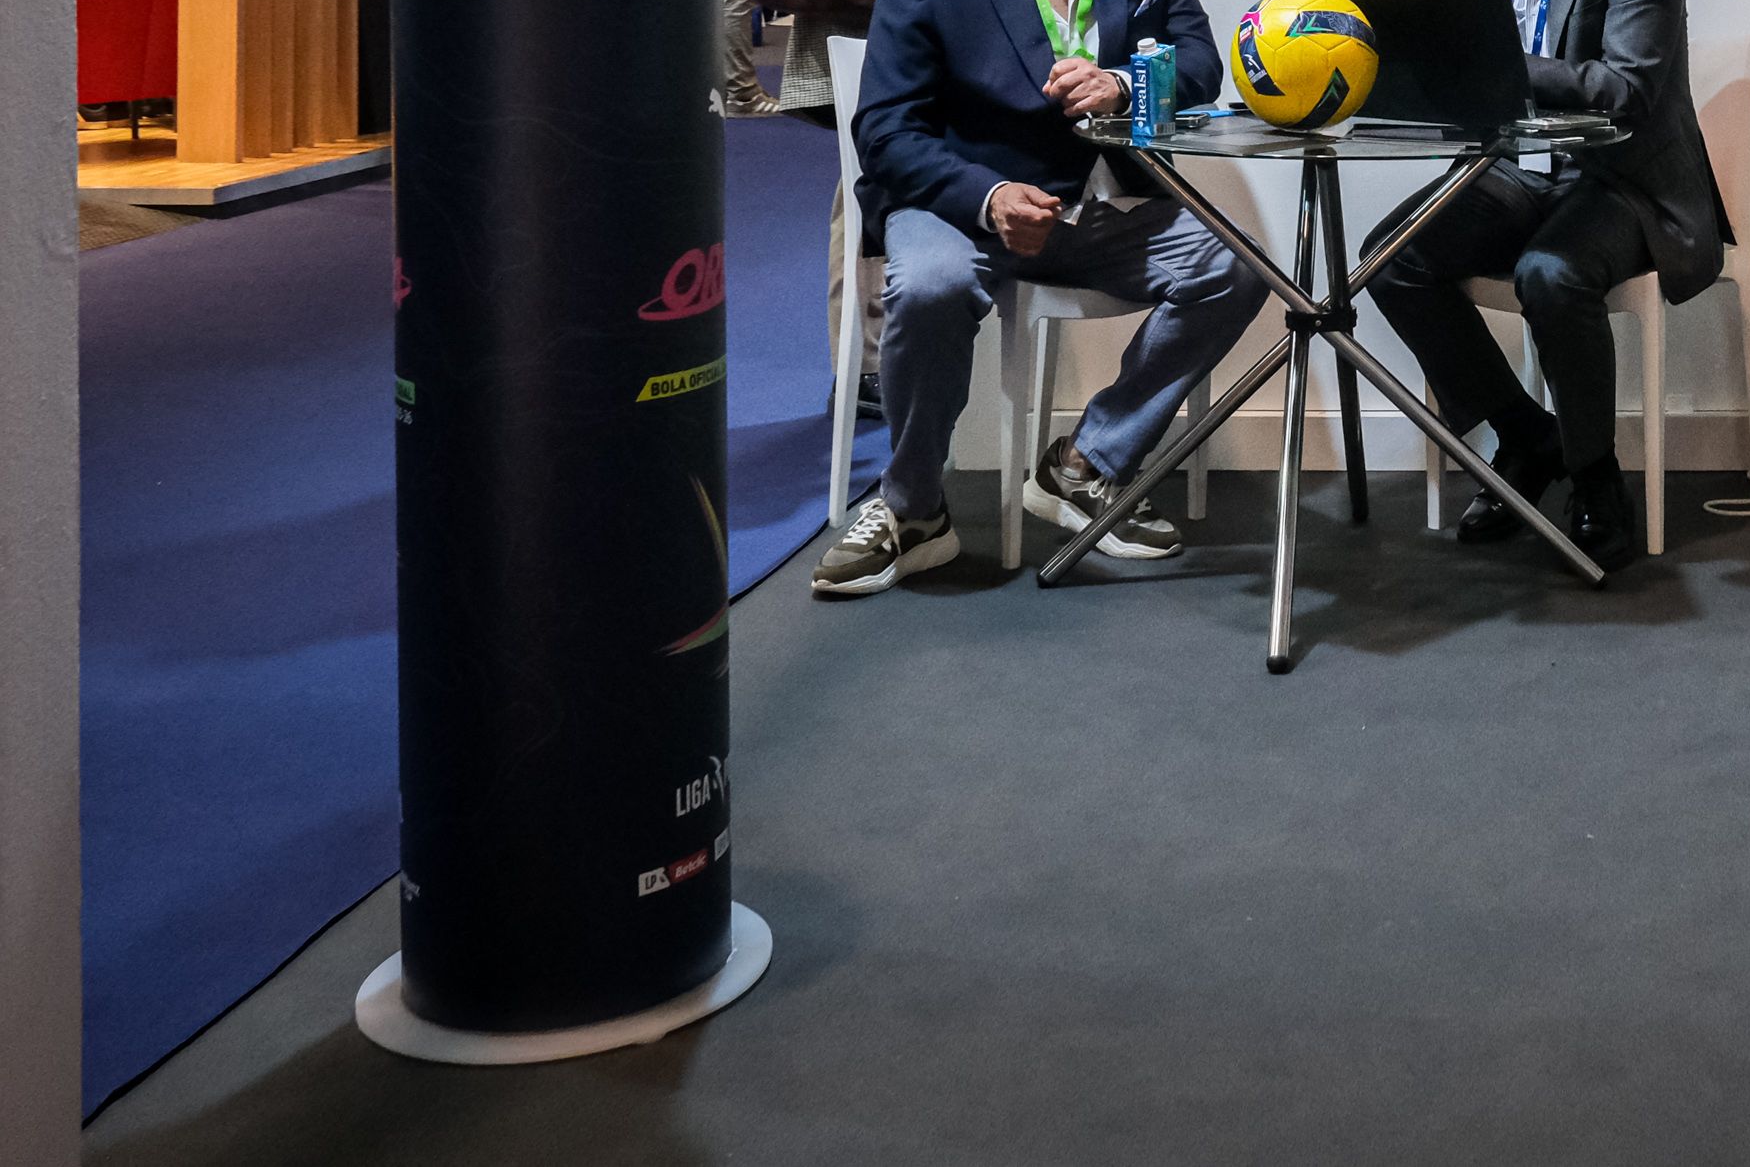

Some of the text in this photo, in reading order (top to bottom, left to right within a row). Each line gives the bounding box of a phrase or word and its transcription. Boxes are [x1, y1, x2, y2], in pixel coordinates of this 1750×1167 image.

[1134, 69, 1147, 122] healsi
[651, 376, 687, 397] BOLA
[676, 773, 711, 818] LIGA
